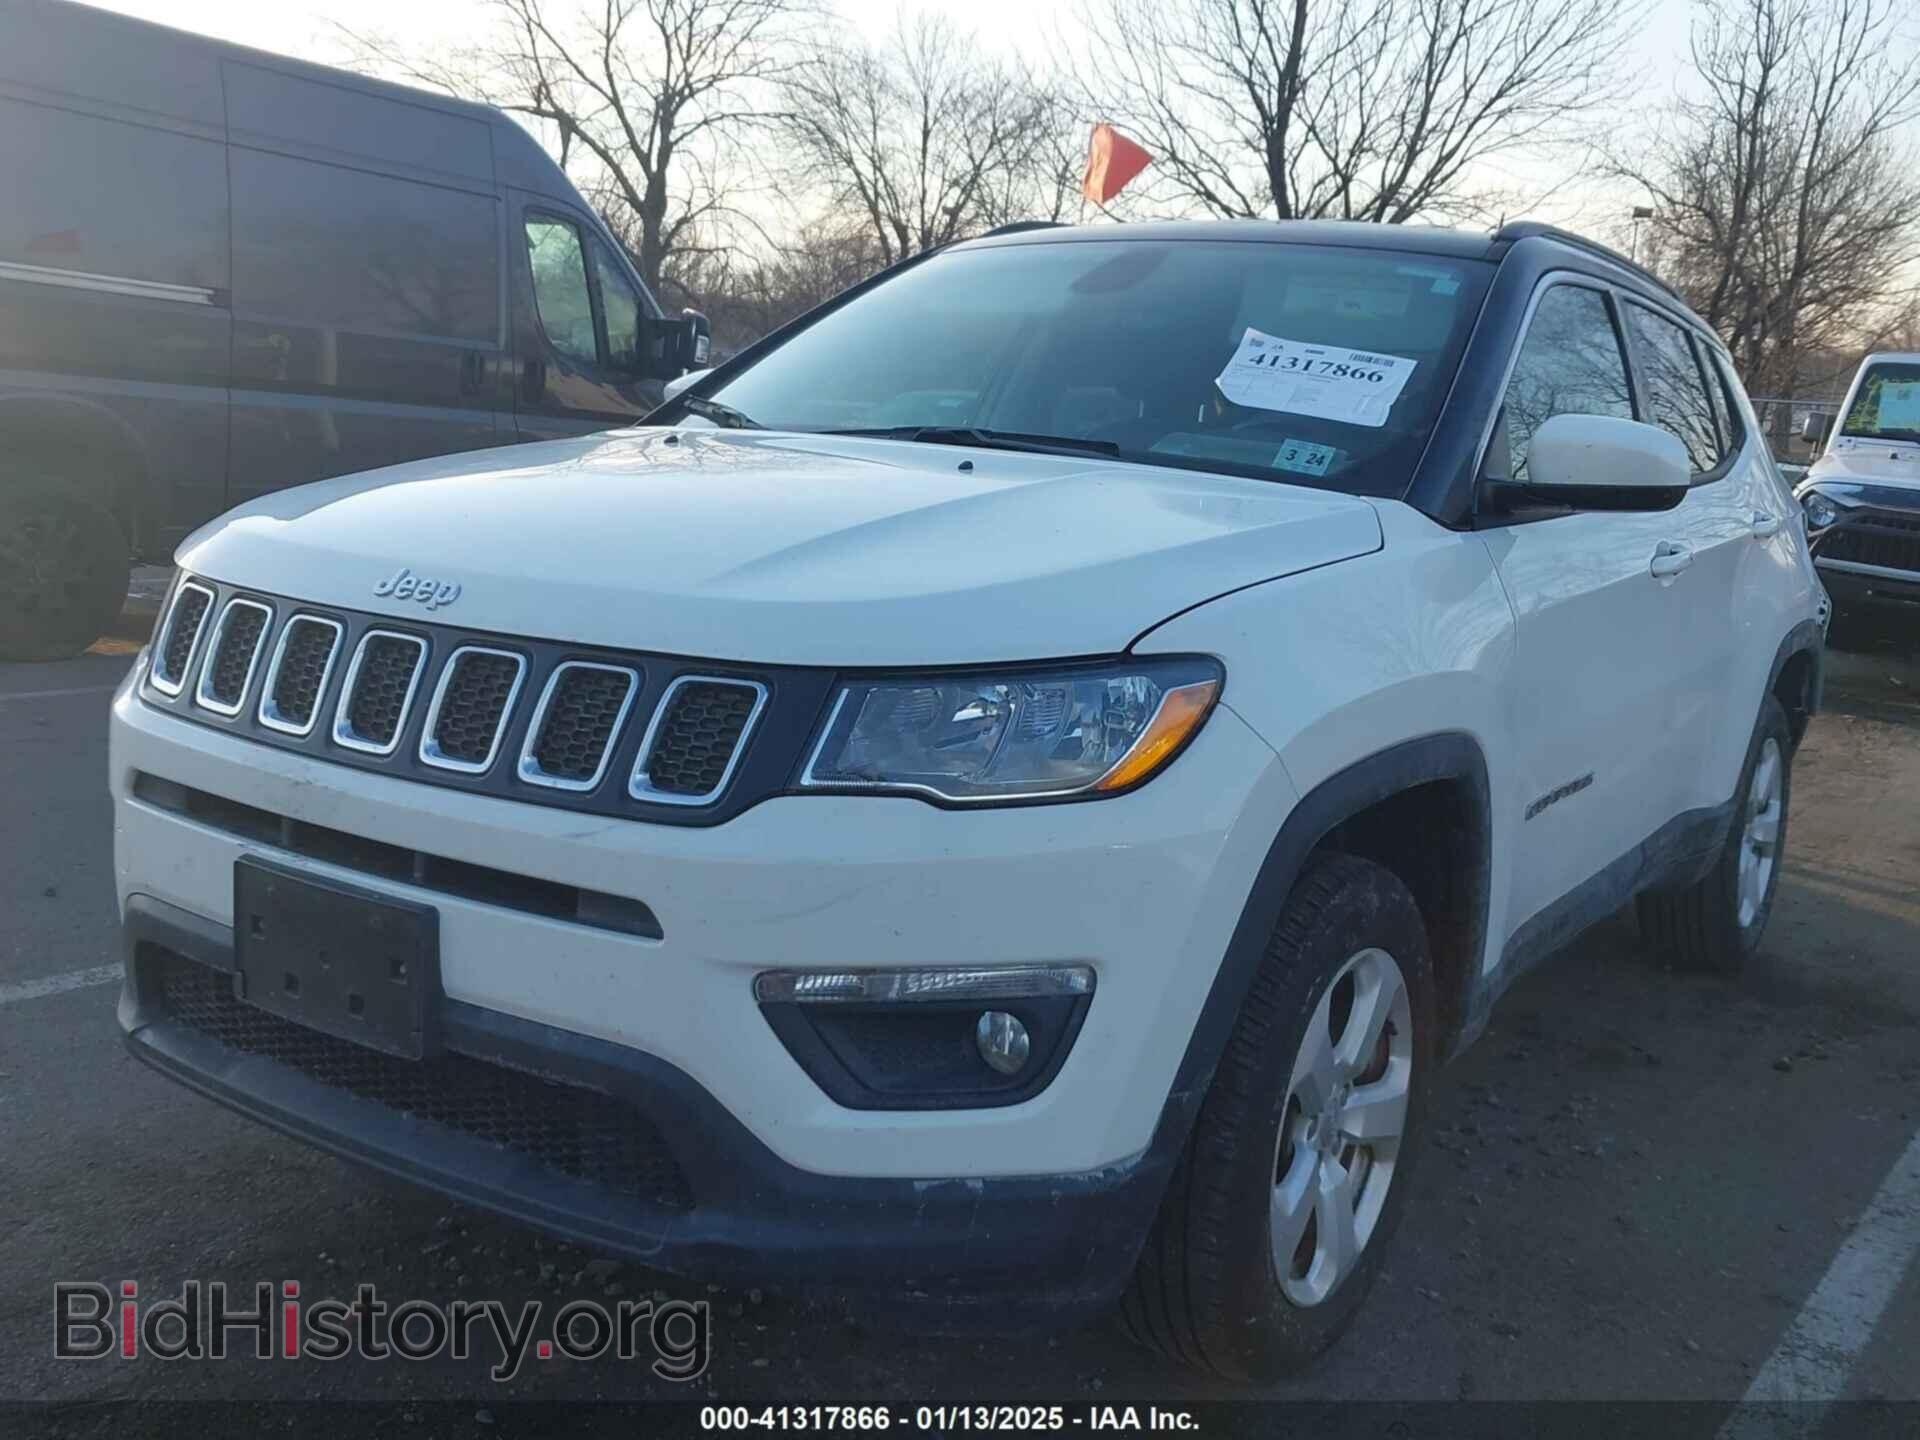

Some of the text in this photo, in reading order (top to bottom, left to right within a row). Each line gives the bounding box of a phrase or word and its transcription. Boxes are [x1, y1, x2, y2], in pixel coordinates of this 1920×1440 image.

[1249, 352, 1384, 383] 41317866
[1286, 449, 1325, 466] 3 24
[374, 567, 462, 611] Jeep
